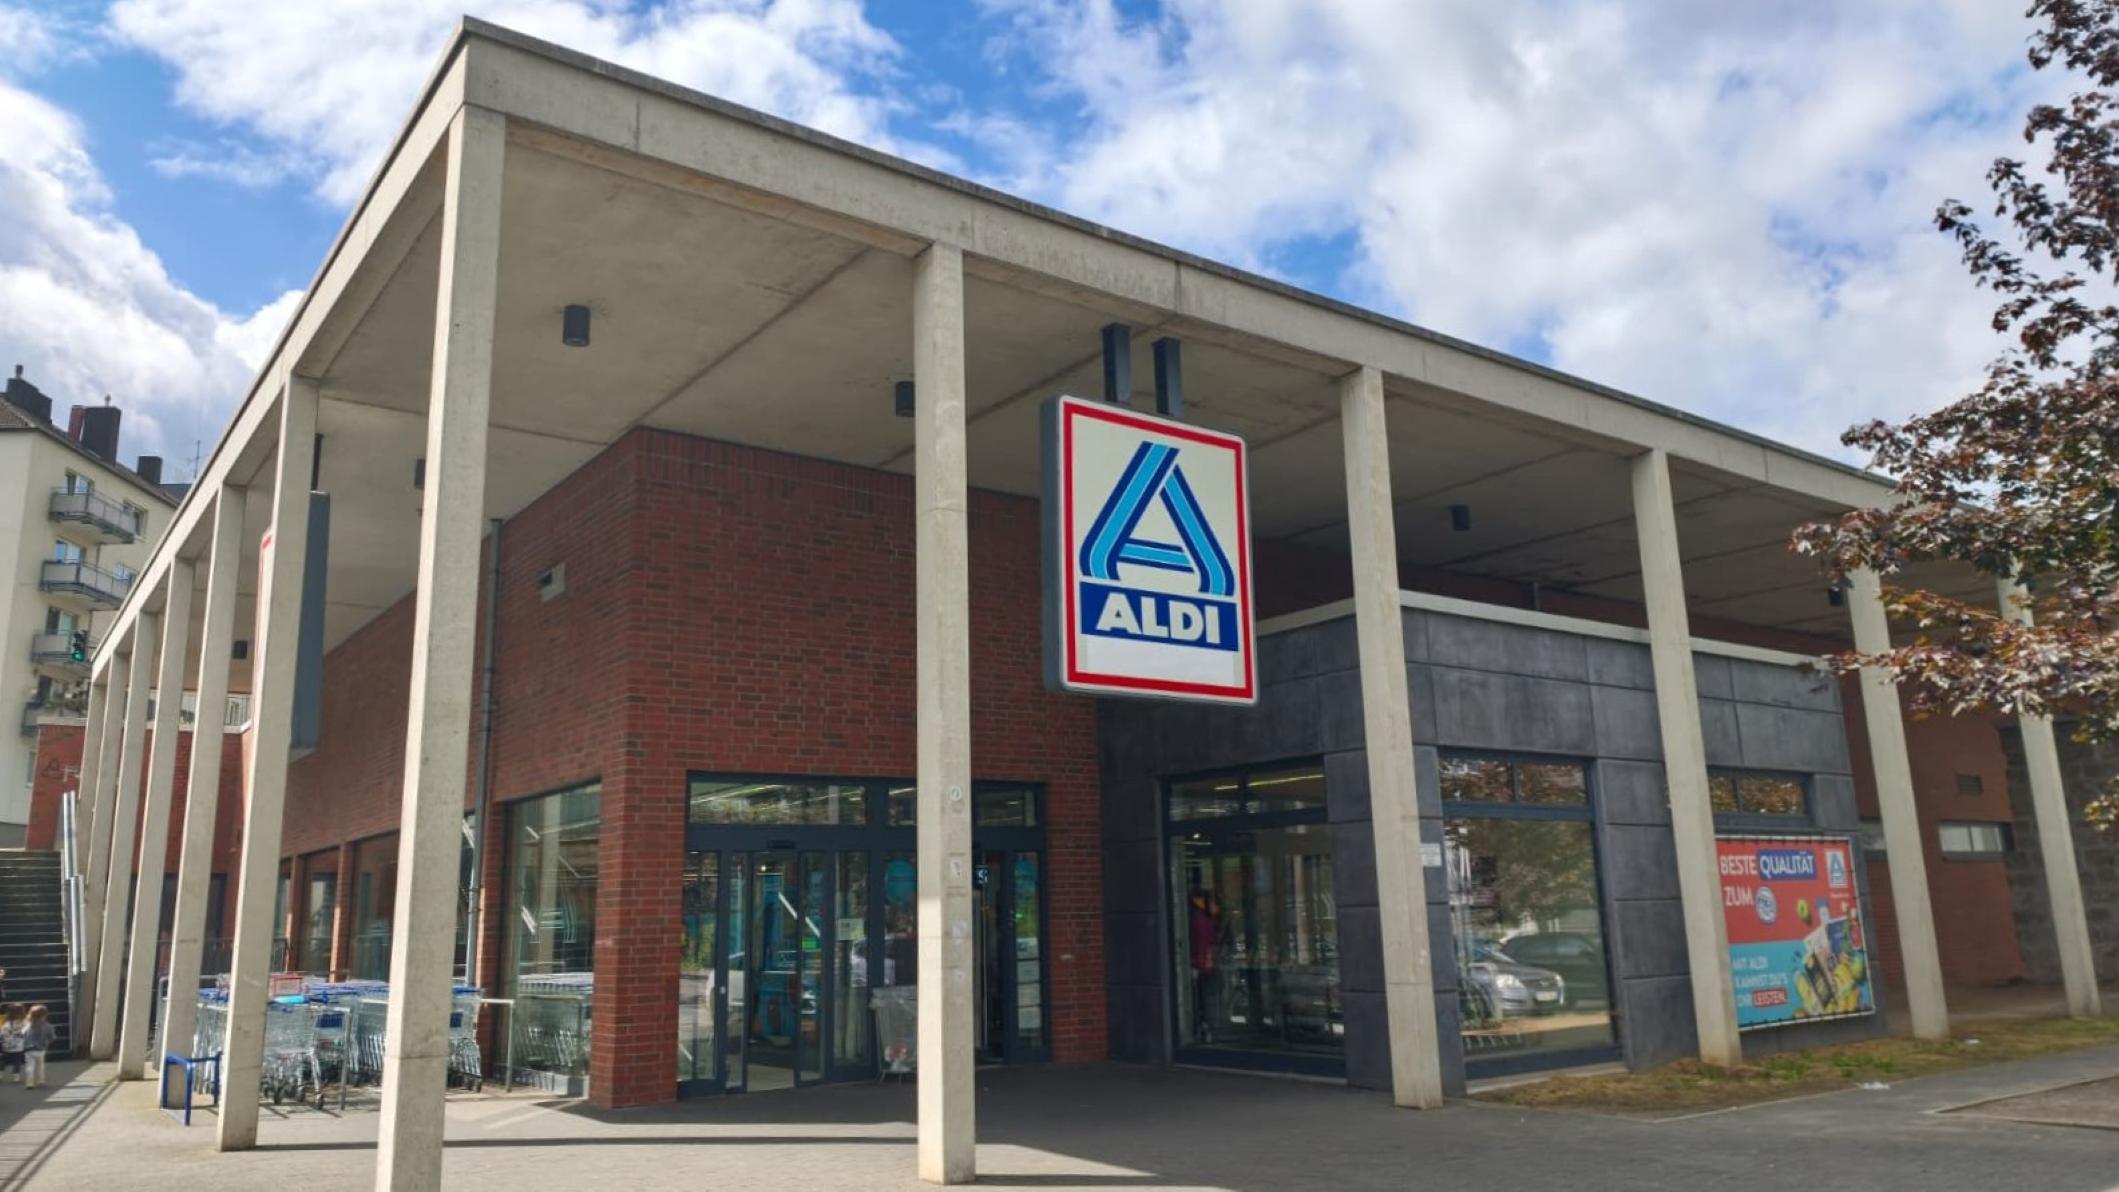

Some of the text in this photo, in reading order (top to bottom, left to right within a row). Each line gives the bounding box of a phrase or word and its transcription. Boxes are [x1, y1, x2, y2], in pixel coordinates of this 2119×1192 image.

[1095, 592, 1221, 645] ALDI
[1720, 851, 1815, 879] BESTE QUALITÄT
[1724, 886, 1754, 907] ZUM
